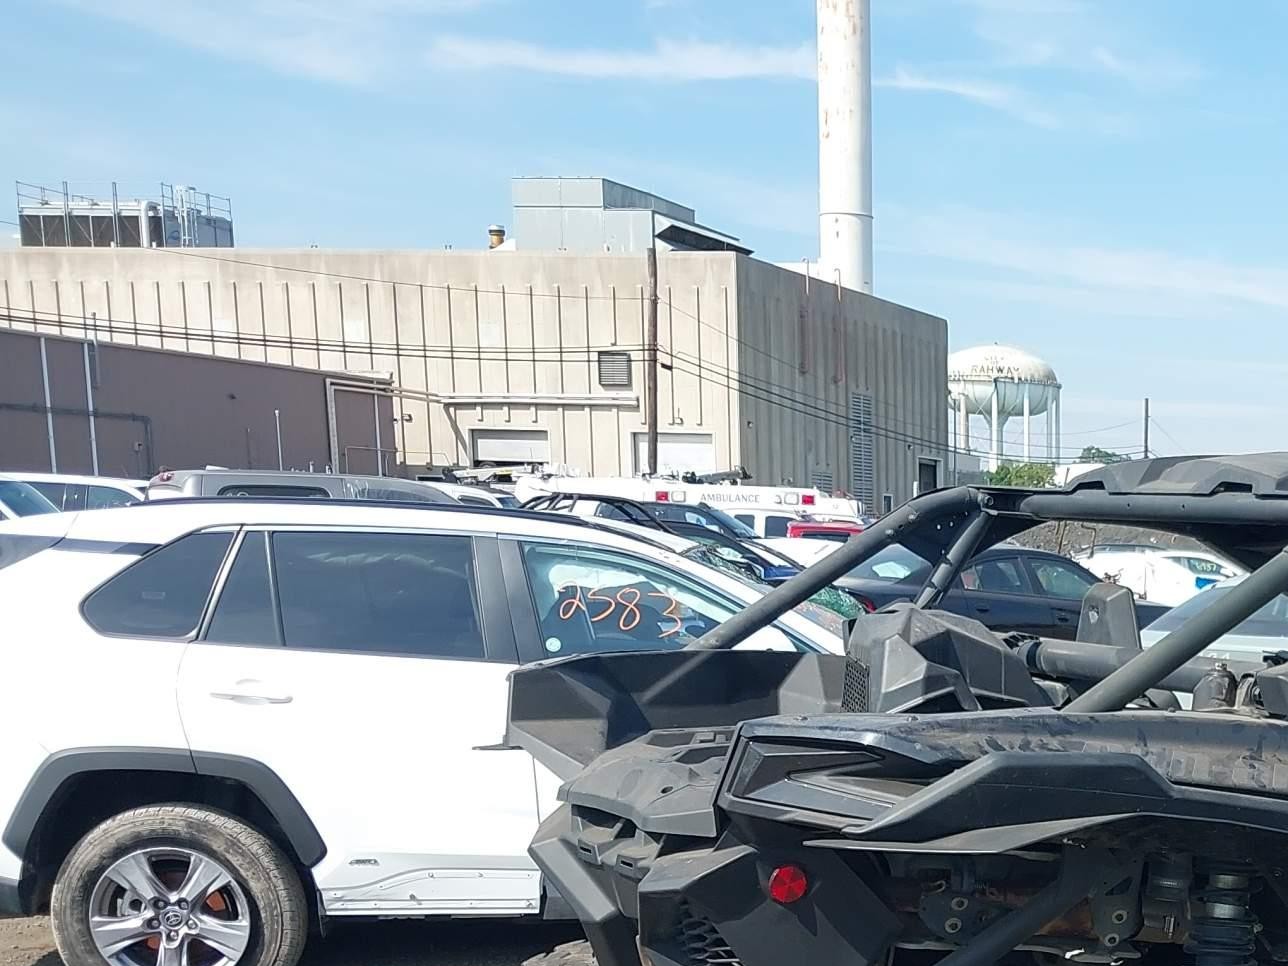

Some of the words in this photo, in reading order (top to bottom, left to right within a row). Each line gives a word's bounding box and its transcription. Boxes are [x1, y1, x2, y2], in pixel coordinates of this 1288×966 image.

[971, 364, 1020, 376] RAHWAY
[700, 493, 760, 504] AMBULANCE
[558, 580, 682, 638] 2583
